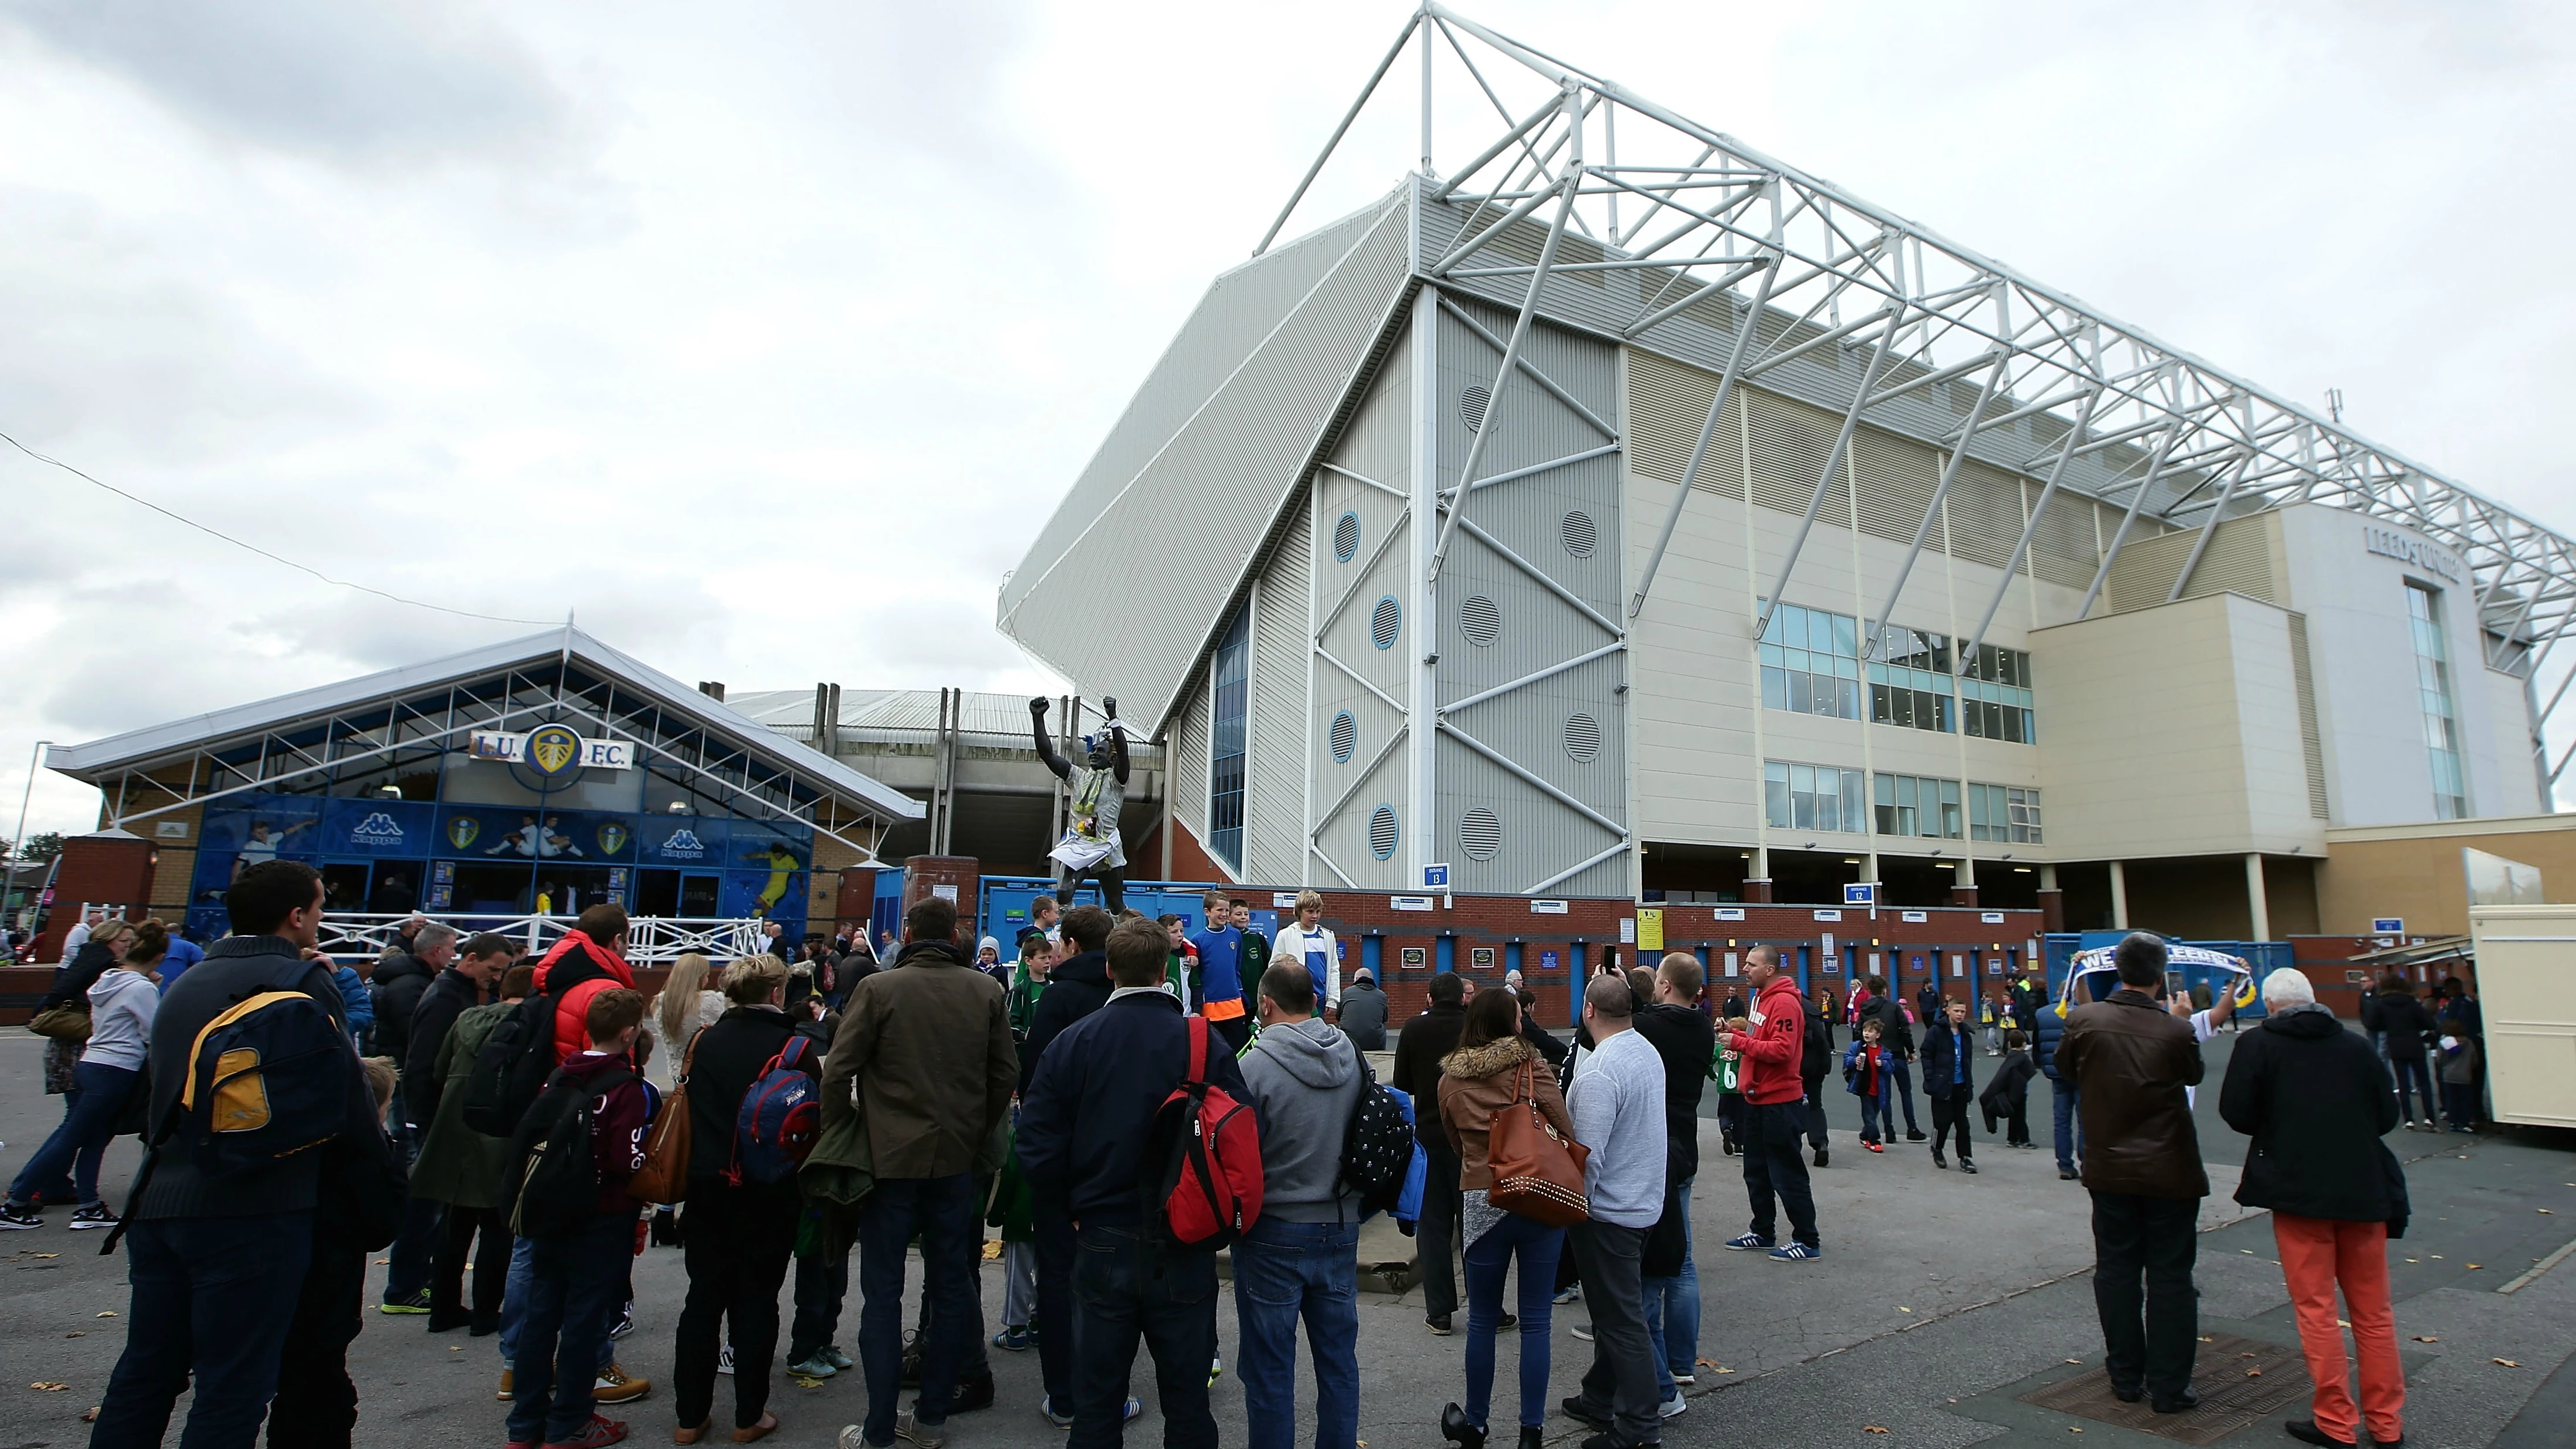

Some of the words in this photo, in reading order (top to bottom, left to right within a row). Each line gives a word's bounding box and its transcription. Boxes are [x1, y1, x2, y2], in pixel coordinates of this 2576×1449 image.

[2364, 526, 2417, 565] LEEDS
[591, 744, 625, 765] F.C.
[351, 834, 402, 846] Kappa
[661, 848, 702, 858] Kappa
[1434, 874, 1440, 884] 13
[2080, 951, 2114, 968] WE
[1776, 1019, 1793, 1033] 72
[1724, 1062, 1736, 1089] 6
